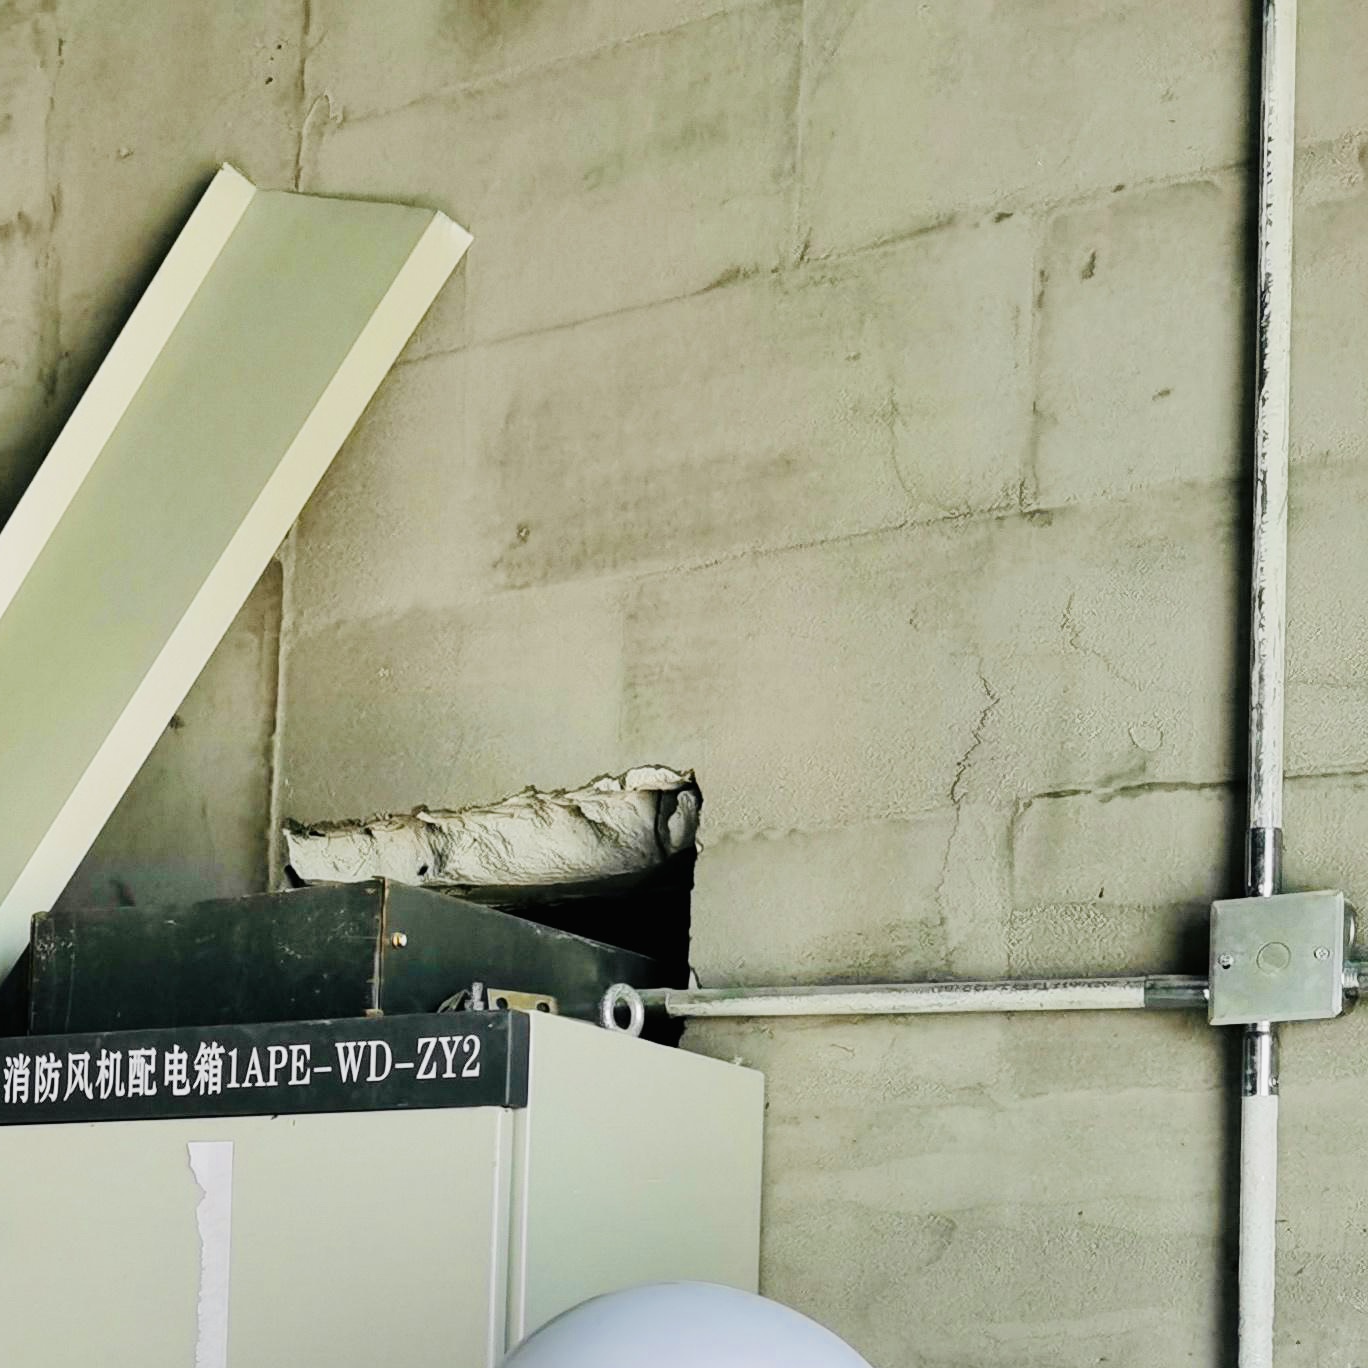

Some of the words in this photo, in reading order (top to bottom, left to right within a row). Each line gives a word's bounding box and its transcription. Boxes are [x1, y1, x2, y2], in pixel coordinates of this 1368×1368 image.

[3, 1035, 481, 1104] 消防风机配电箱1APE-WD-ZY2
